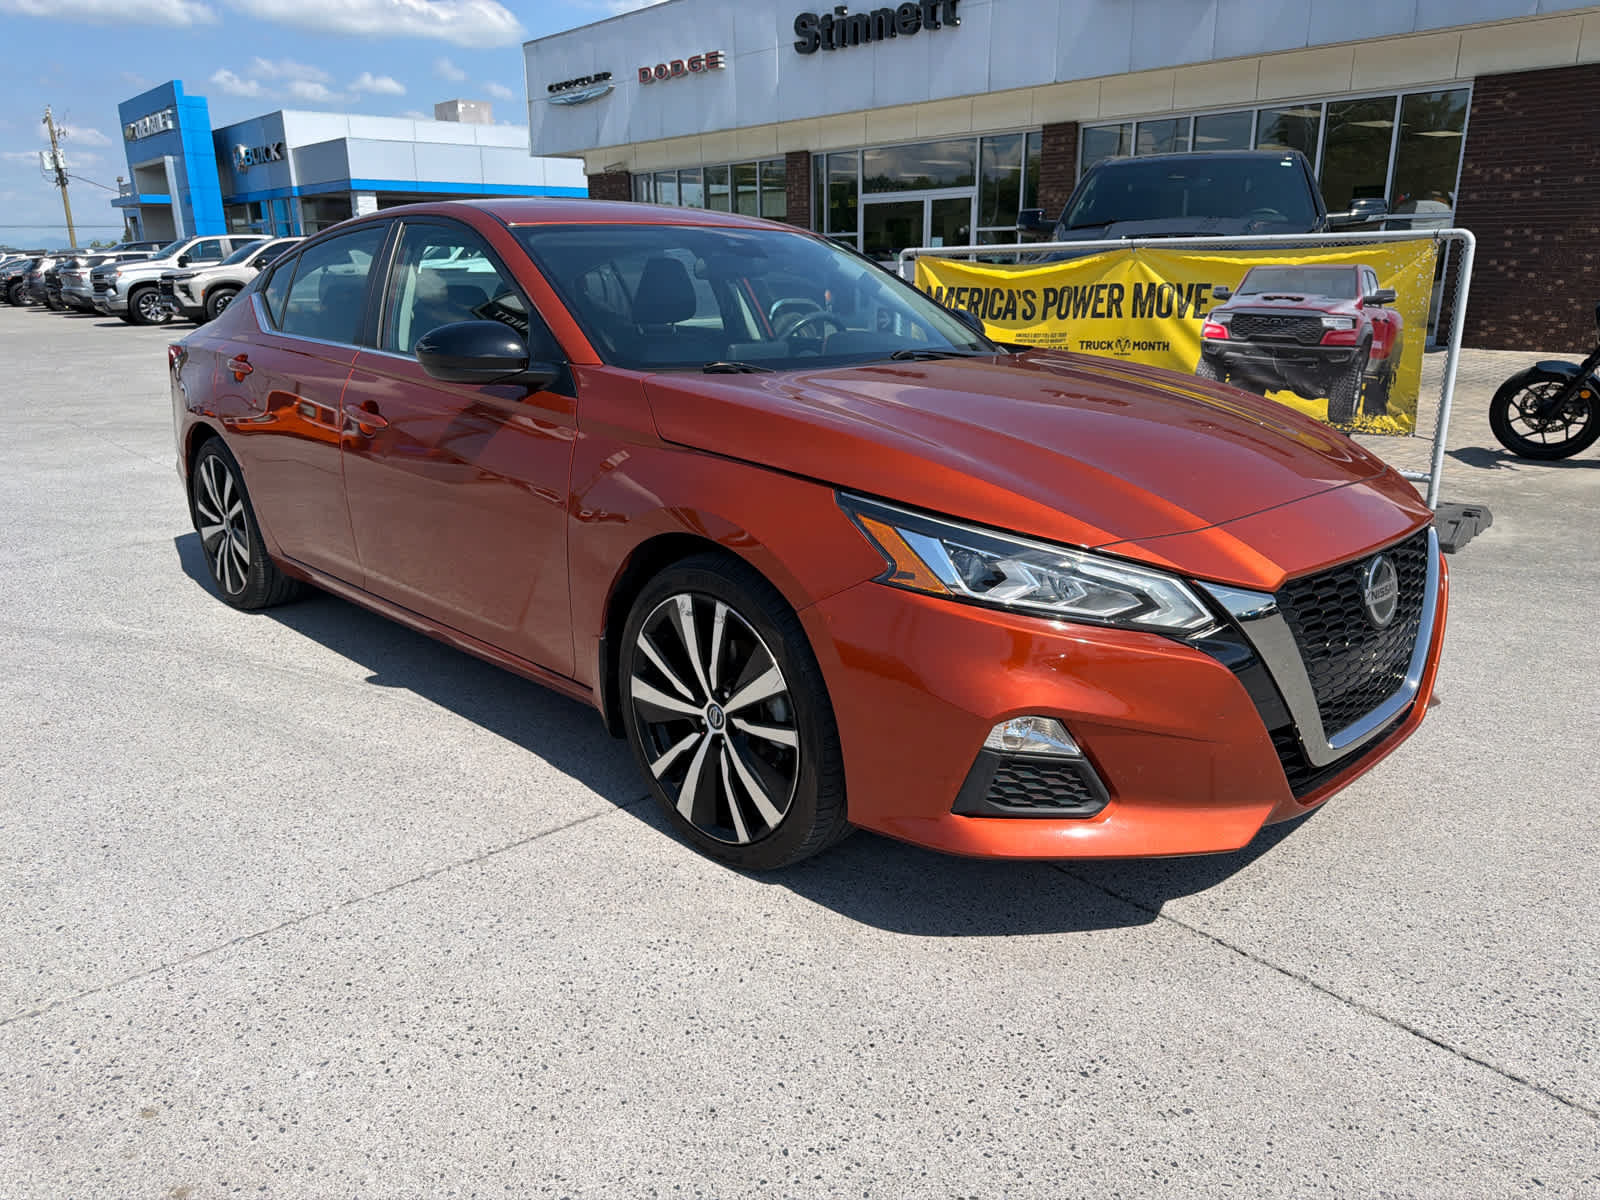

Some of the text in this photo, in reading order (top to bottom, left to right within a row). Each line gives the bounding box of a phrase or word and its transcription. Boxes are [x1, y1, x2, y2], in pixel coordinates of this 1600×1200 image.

[794, 0, 960, 54] Stinnett
[638, 50, 725, 84] DODGE
[244, 142, 284, 167] BUICK
[1041, 283, 1125, 321] POWER
[1131, 282, 1212, 320] MOVE
[1079, 340, 1114, 350] TRUCK
[1132, 341, 1170, 351] MONTH
